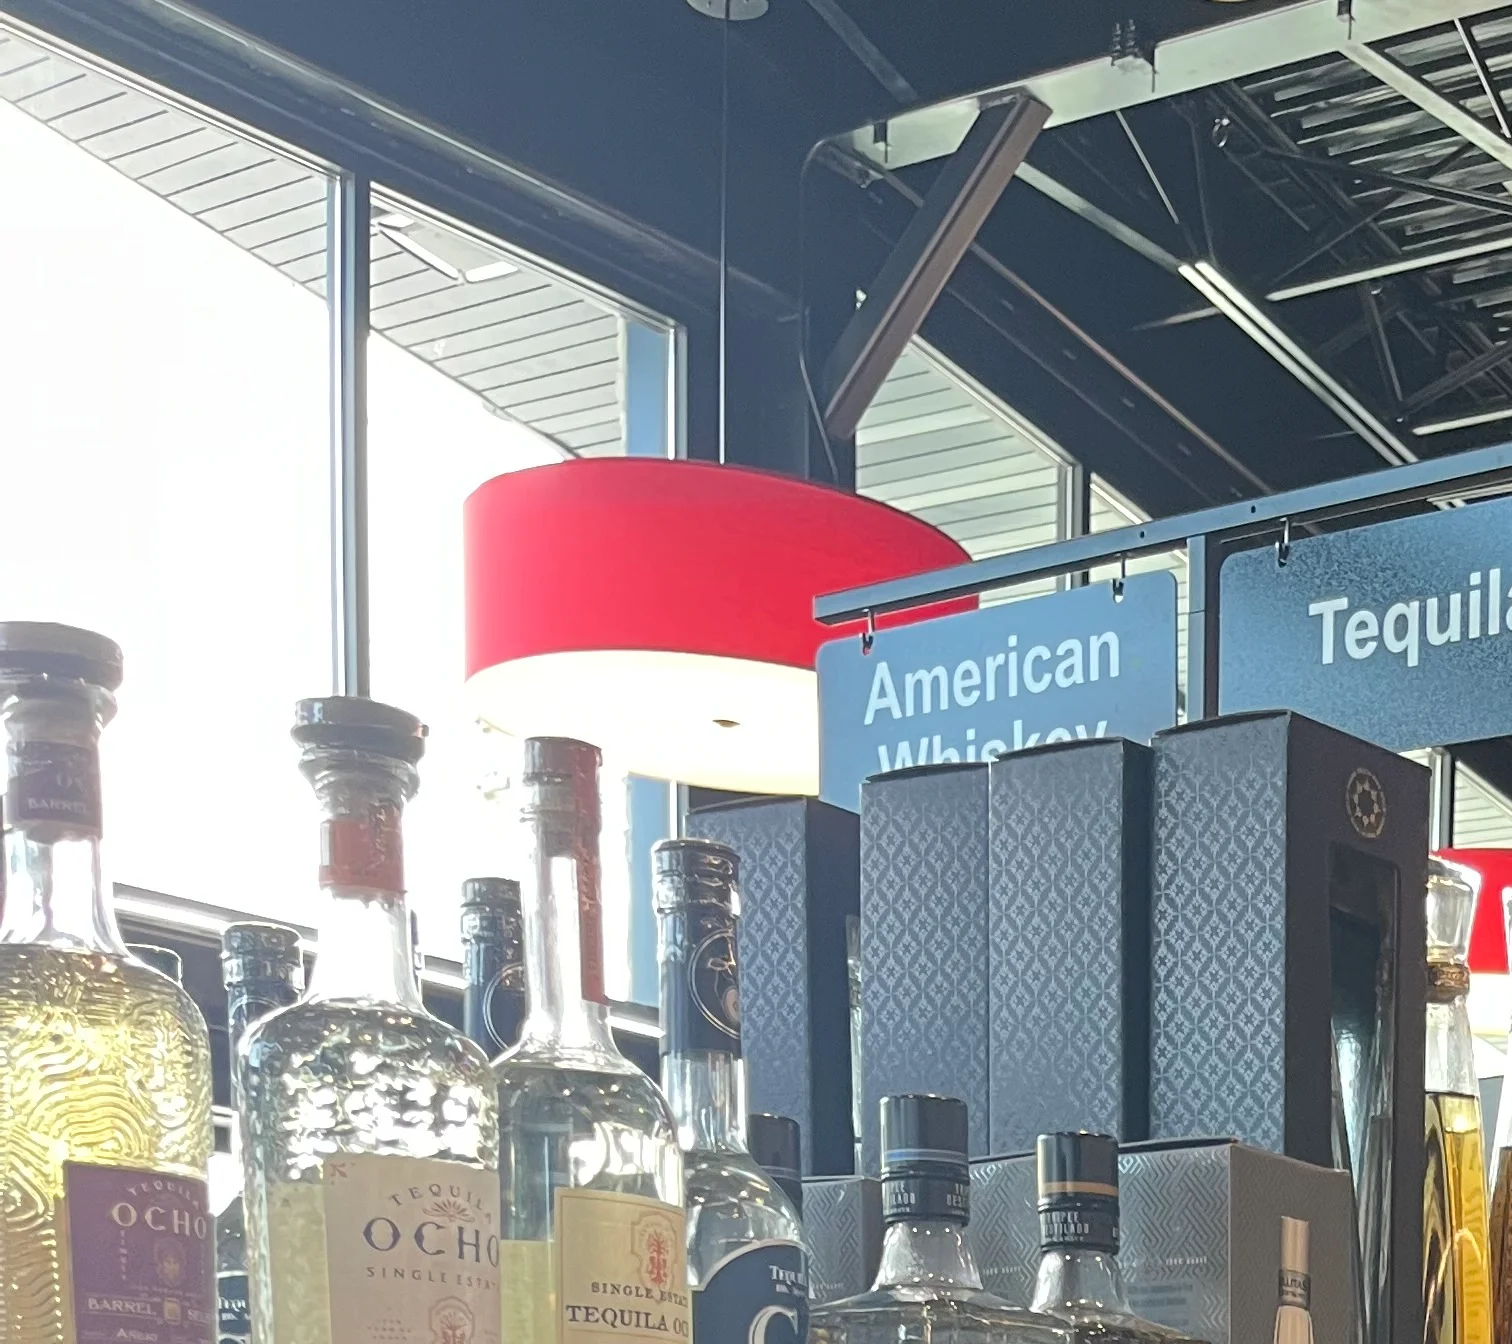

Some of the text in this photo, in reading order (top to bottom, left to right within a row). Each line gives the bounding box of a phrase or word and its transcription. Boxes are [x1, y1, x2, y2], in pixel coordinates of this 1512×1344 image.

[864, 631, 1120, 726] American
[111, 1202, 208, 1240] OCHO
[363, 1217, 500, 1268] OCHO
[366, 1266, 448, 1284] SINGLE
[591, 1281, 654, 1300] SINGLE
[565, 1304, 669, 1332] TEQUILA
